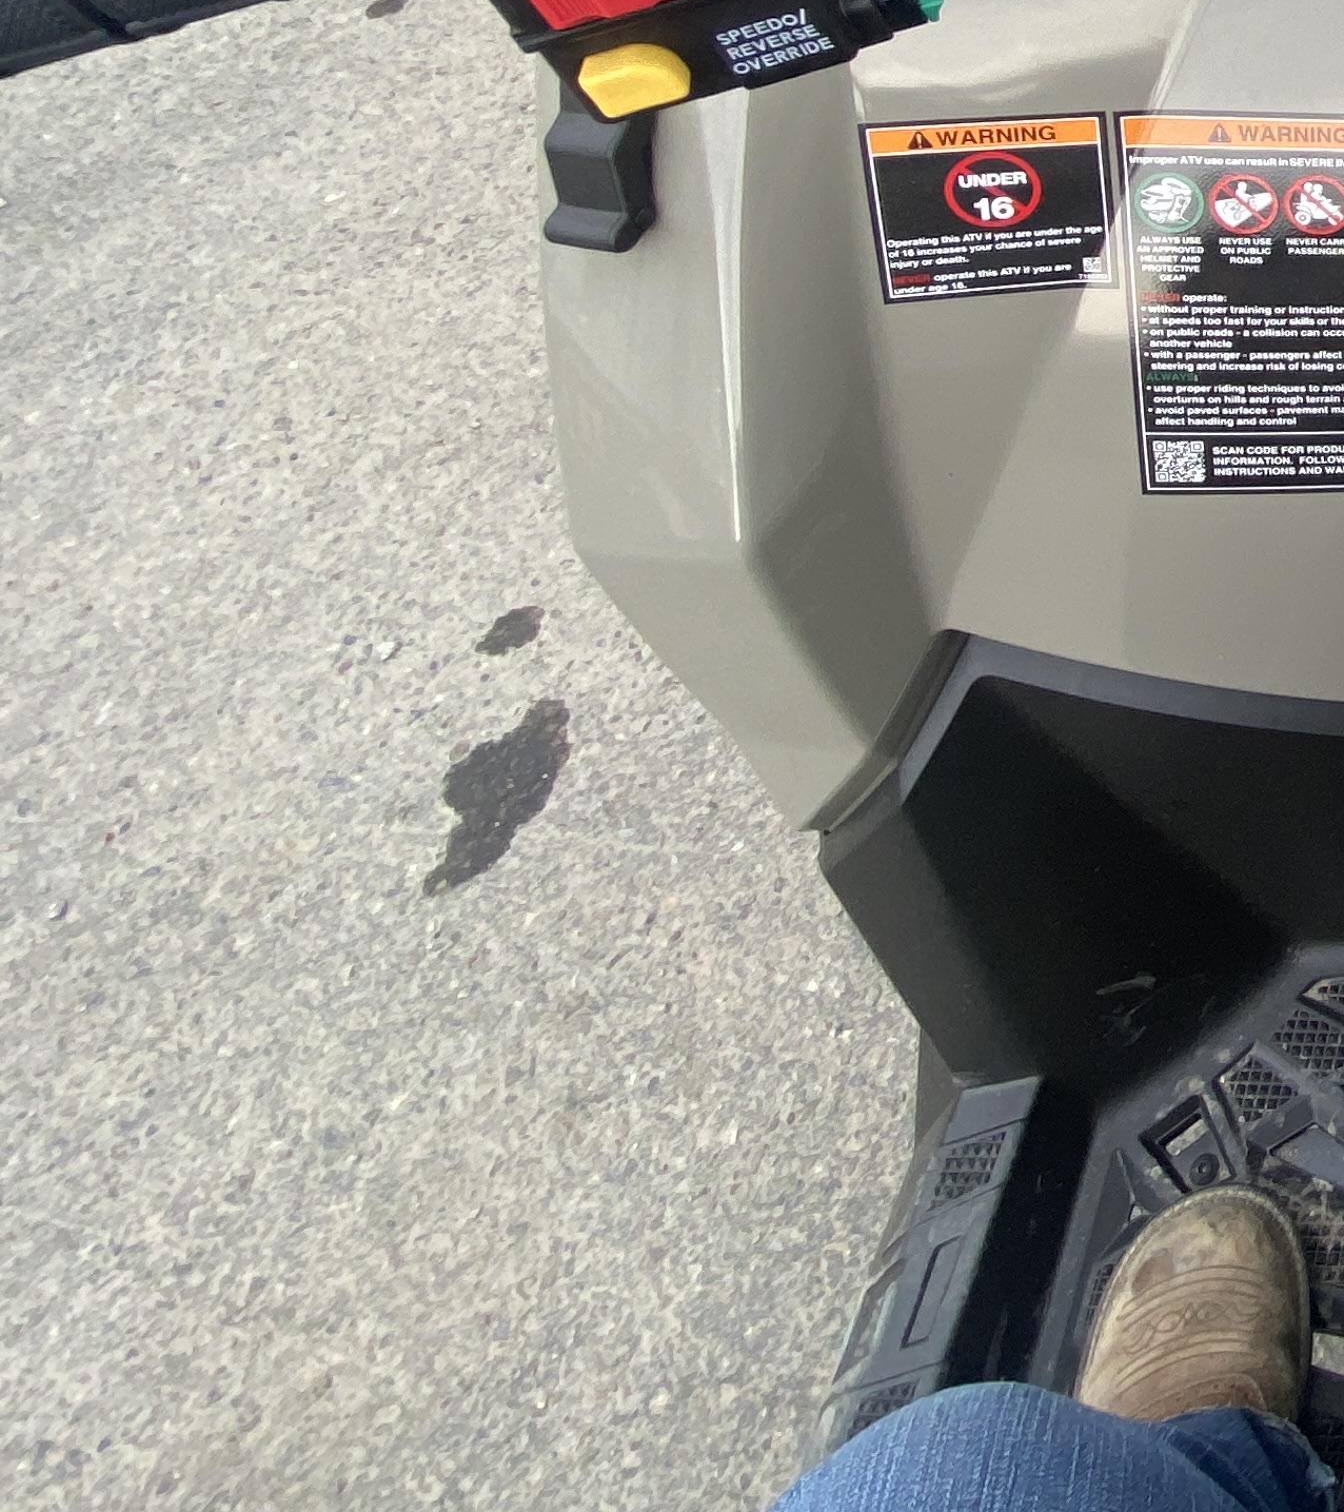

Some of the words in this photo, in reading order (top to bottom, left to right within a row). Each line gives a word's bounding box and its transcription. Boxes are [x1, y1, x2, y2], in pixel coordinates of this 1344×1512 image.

[715, 8, 807, 47] SPEEDO/
[726, 24, 820, 61] REVERSE
[733, 37, 834, 75] OVERRIDE
[936, 125, 1057, 146] WARNING
[1129, 154, 1178, 165] Improper
[1181, 155, 1202, 165] ATV
[1204, 158, 1222, 166] use
[1225, 158, 1244, 166] can
[1290, 158, 1334, 168] SEVERE
[958, 171, 1027, 188] UNDER
[973, 196, 1015, 221] 16
[886, 237, 939, 250] Operating
[942, 235, 961, 244] this
[963, 233, 983, 242] ATV
[994, 232, 1013, 242] you
[1016, 230, 1032, 238] are
[1035, 226, 1063, 237] under
[1066, 226, 1081, 234] the
[1084, 225, 1102, 235] age
[1286, 238, 1317, 246] NEVER
[888, 250, 899, 259] of
[902, 248, 914, 257] 16
[916, 244, 967, 256] increases
[970, 244, 992, 254] your
[995, 240, 1033, 250] chance
[1035, 239, 1045, 247] of
[1048, 237, 1081, 246] severe
[1220, 247, 1234, 255] ON
[1237, 247, 1272, 255] PUBLIC
[889, 259, 920, 271] injury
[922, 258, 933, 266] or
[936, 255, 969, 265] death.
[1230, 256, 1263, 264] ROADS
[1212, 446, 1244, 455] SCAN
[1247, 446, 1278, 454] CODE
[1281, 445, 1304, 454] FOR
[1213, 456, 1294, 465] INFORMATION.
[1214, 467, 1296, 476] INSTRUCTIONS
[1299, 466, 1322, 475] AND
